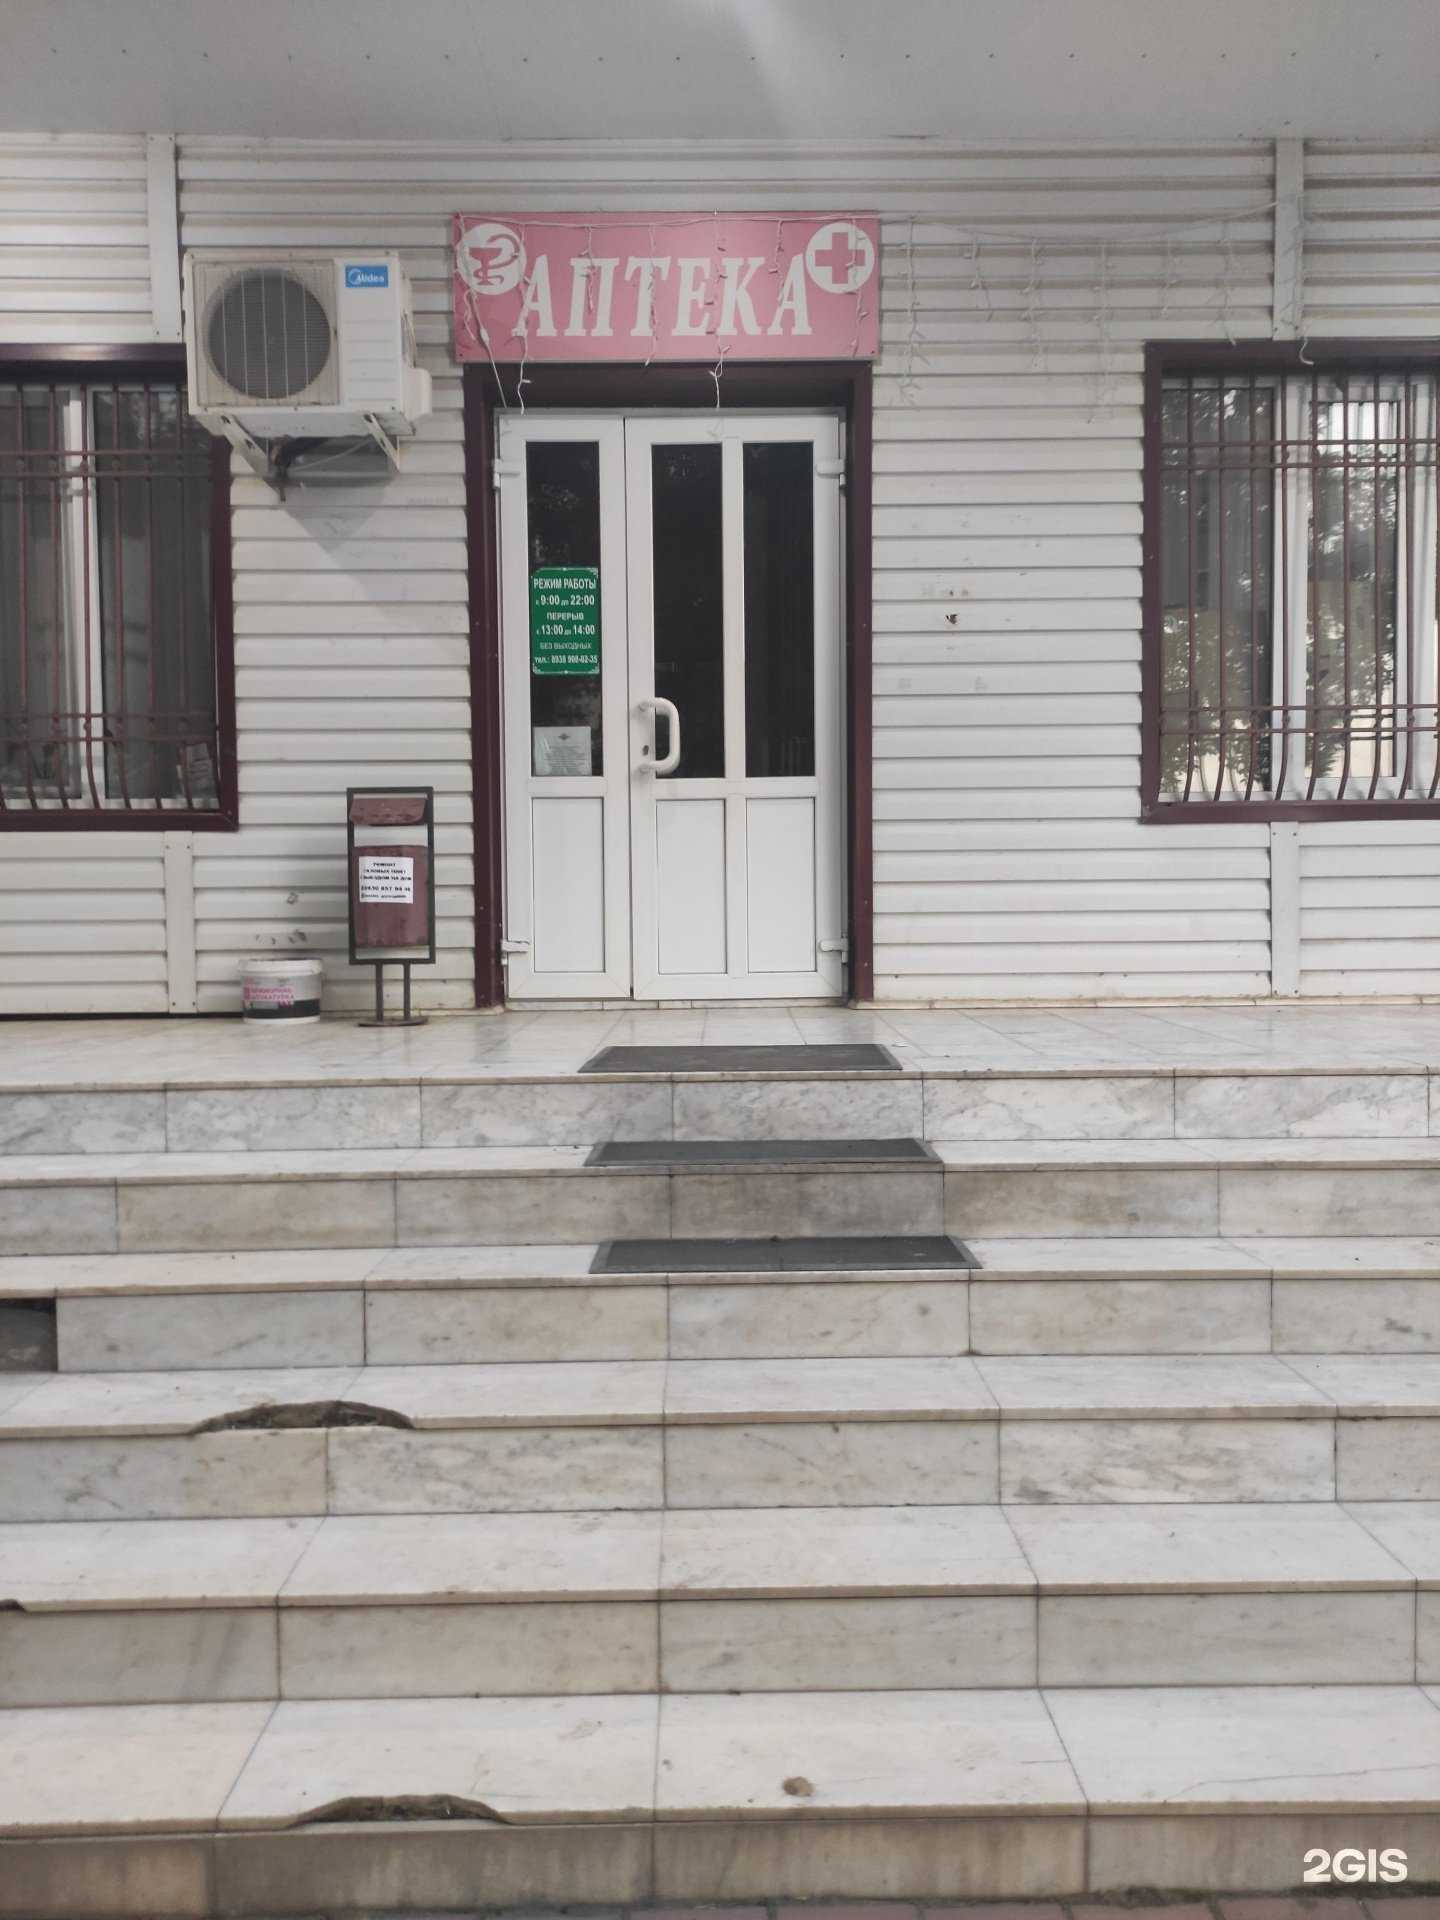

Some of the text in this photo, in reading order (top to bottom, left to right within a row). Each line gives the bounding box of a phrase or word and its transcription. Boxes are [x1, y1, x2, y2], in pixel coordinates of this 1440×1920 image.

[511, 253, 813, 337] АПТЕКА
[533, 578, 597, 589] РЕЖИМ РАБОТЫ
[540, 594, 560, 606] 9:00
[570, 594, 595, 606] 22:00
[546, 612, 585, 621] ПЕРЕРЫВ
[541, 624, 564, 635] 13:00
[573, 624, 595, 635] 14:00
[540, 642, 592, 650] БЕЗ ВЫХОДНЫХ
